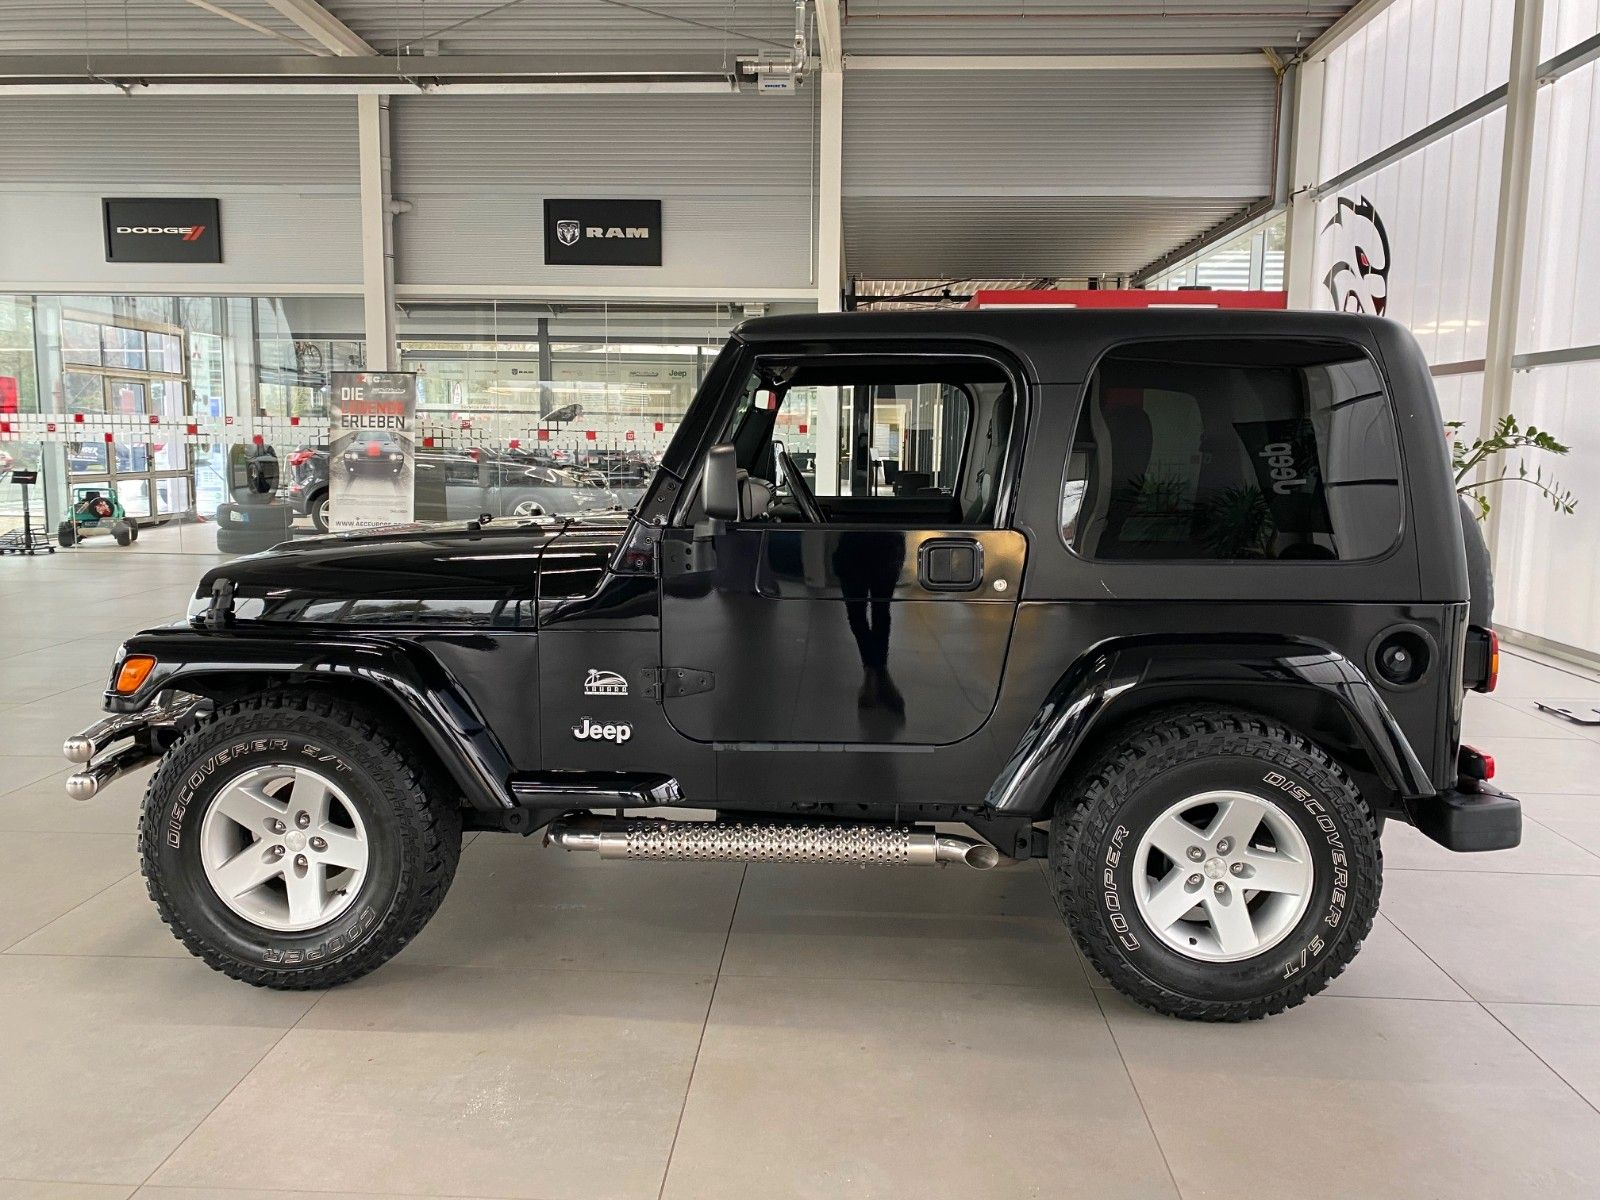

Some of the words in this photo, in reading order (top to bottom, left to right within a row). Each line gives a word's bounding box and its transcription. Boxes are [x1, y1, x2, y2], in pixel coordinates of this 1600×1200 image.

[116, 226, 193, 234] DODGE
[585, 227, 649, 238] RAM
[669, 369, 687, 378] Jeep
[341, 387, 364, 401] DIE
[341, 415, 405, 428] ERLEBEN
[572, 717, 632, 744] Jeep
[166, 738, 289, 849] DISCOVERER
[301, 743, 353, 773] S/T
[1262, 771, 1350, 929] DISCOVERER
[1103, 825, 1140, 951] COOPER
[262, 905, 376, 964] COOPER
[1283, 934, 1325, 980] S/T
